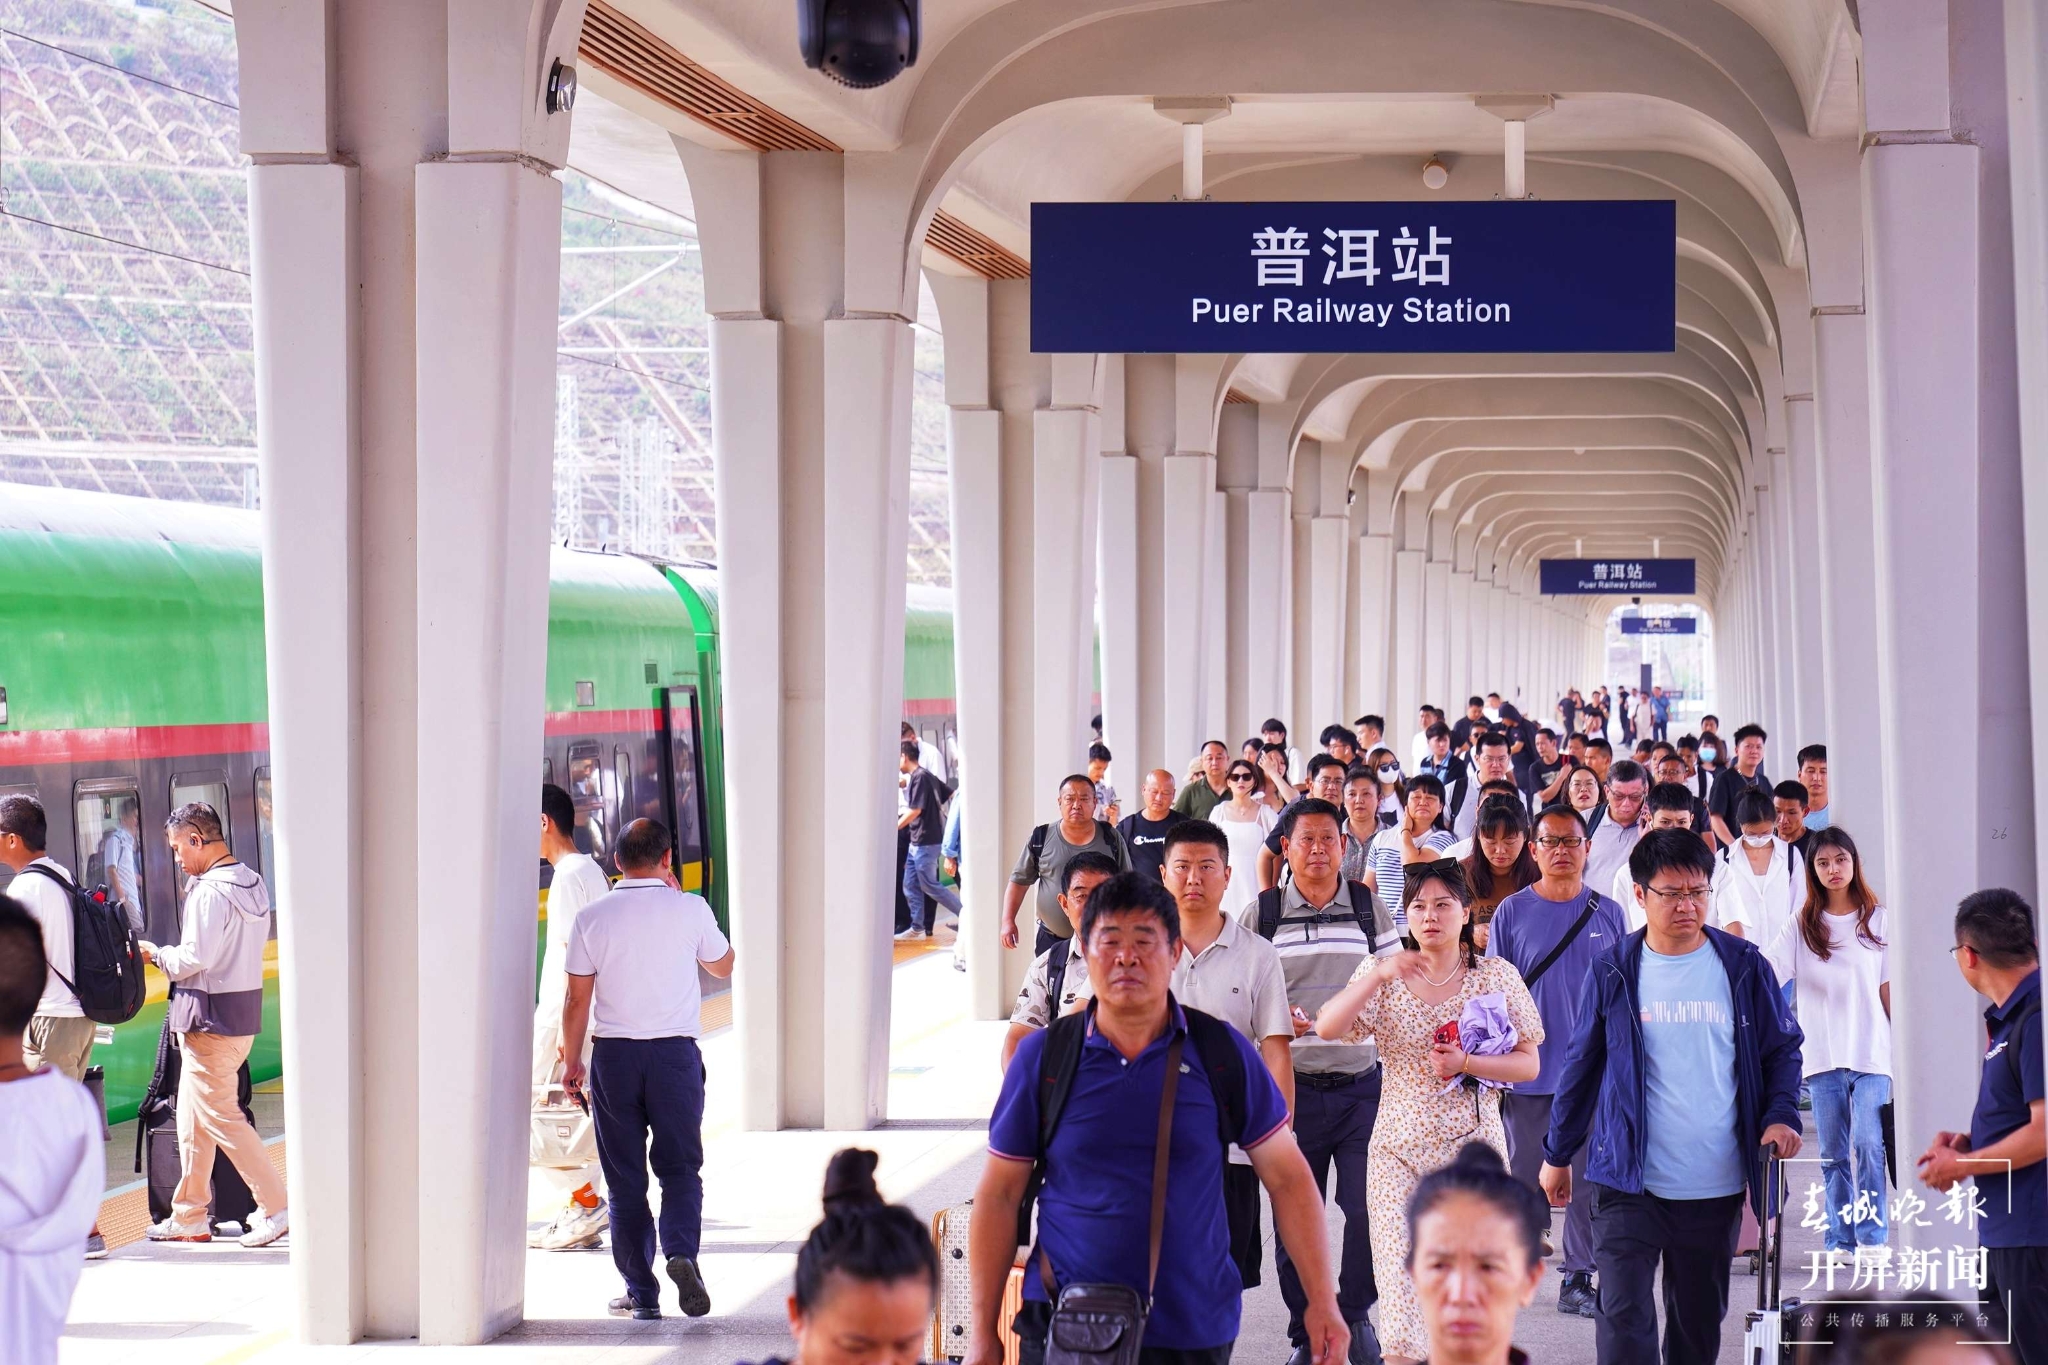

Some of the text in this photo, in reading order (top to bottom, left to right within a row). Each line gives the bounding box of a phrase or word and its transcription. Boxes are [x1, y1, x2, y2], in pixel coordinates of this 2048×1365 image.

[1250, 225, 1452, 287] 普洱站
[1191, 297, 1511, 328] Puer Railway Station
[1592, 563, 1643, 580] 普洱站
[1578, 580, 1657, 590] Puer Railway Station
[1991, 826, 2008, 840] 26
